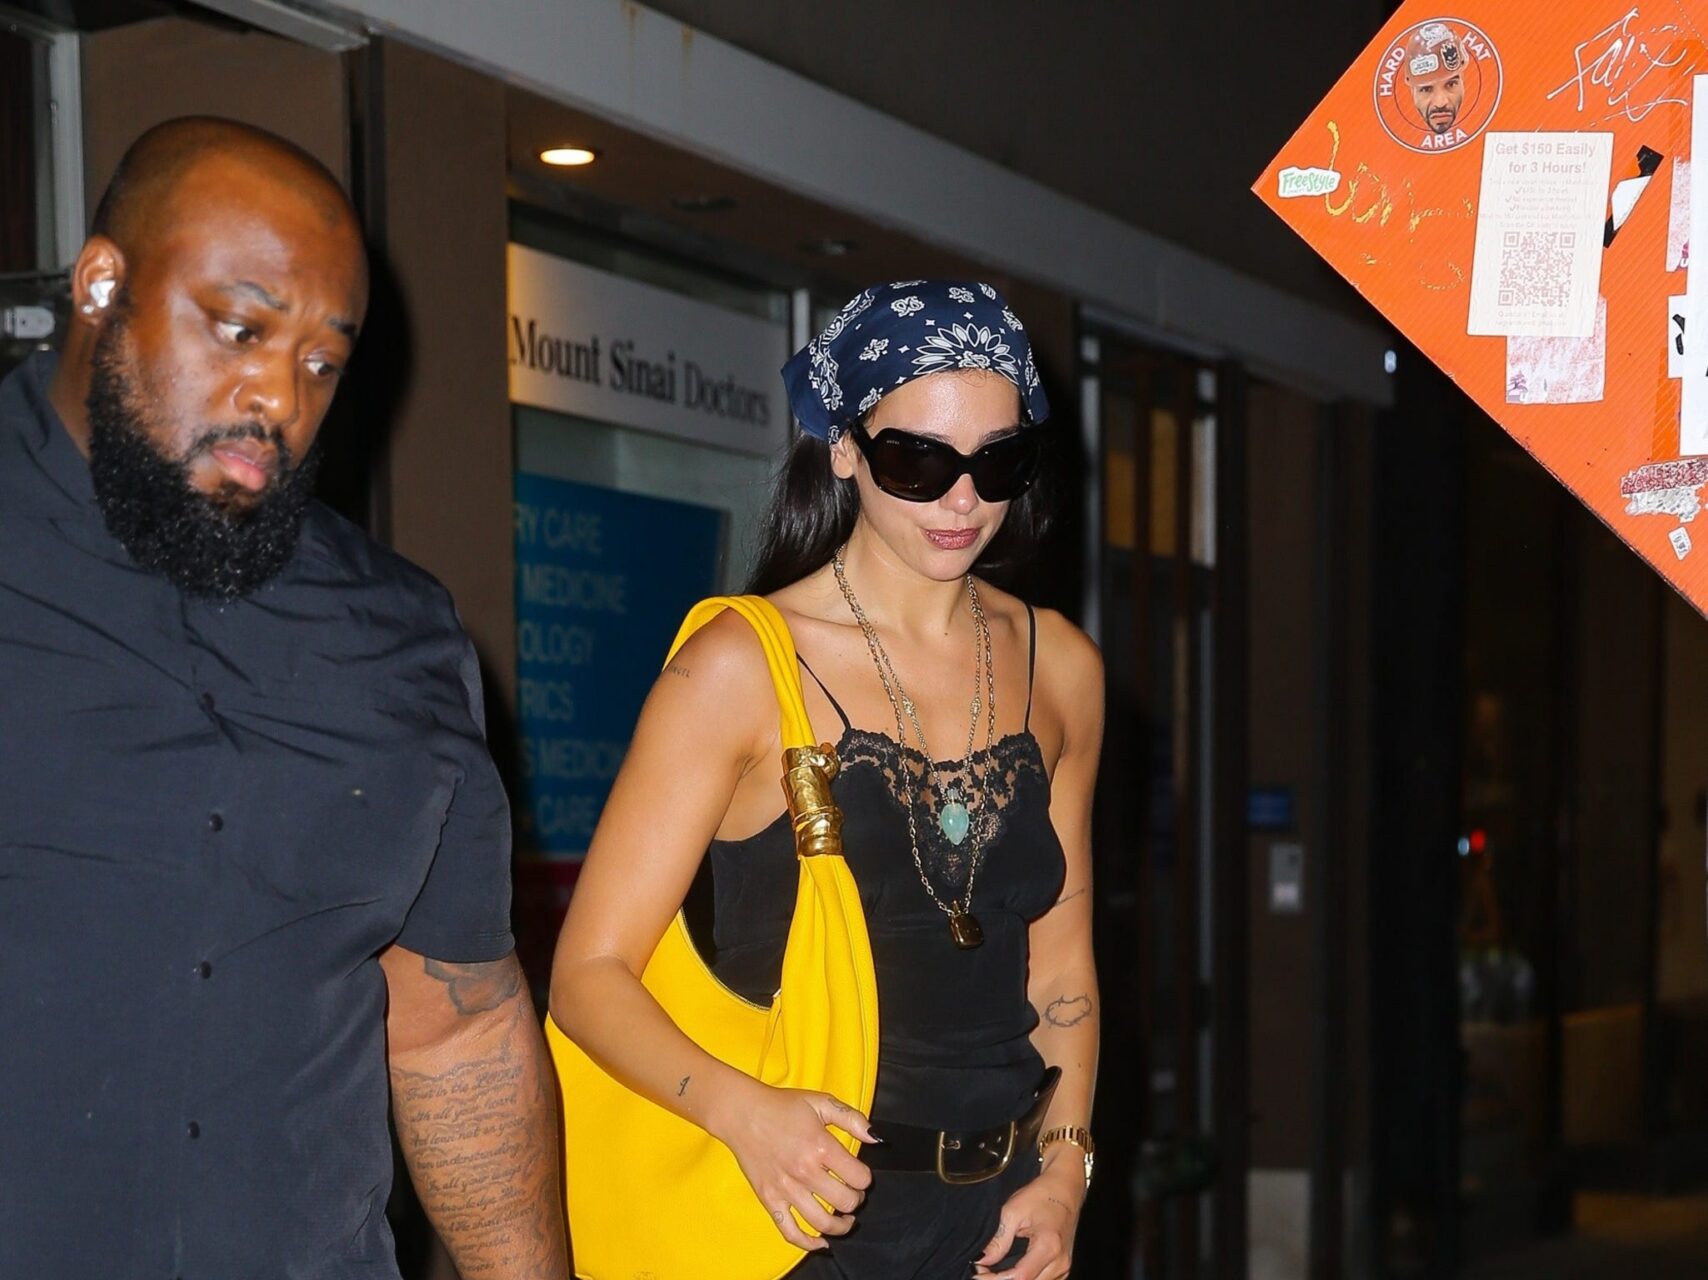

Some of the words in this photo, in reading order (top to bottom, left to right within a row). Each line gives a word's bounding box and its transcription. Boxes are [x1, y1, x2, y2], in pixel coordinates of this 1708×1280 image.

[1380, 47, 1405, 97] HARD
[1462, 31, 1492, 62] HAT
[1420, 129, 1469, 149] AREA
[1495, 142, 1518, 155] Get
[1521, 142, 1553, 156] $150
[1556, 142, 1596, 158] Easily
[1508, 161, 1526, 173] for
[1530, 161, 1539, 173] 3
[1542, 161, 1587, 174] Hours!
[509, 315, 601, 386] Mount
[609, 338, 676, 406] Sinai
[684, 360, 771, 427] Doctors
[543, 507, 603, 555] CARE
[522, 562, 627, 615] MEDICINE
